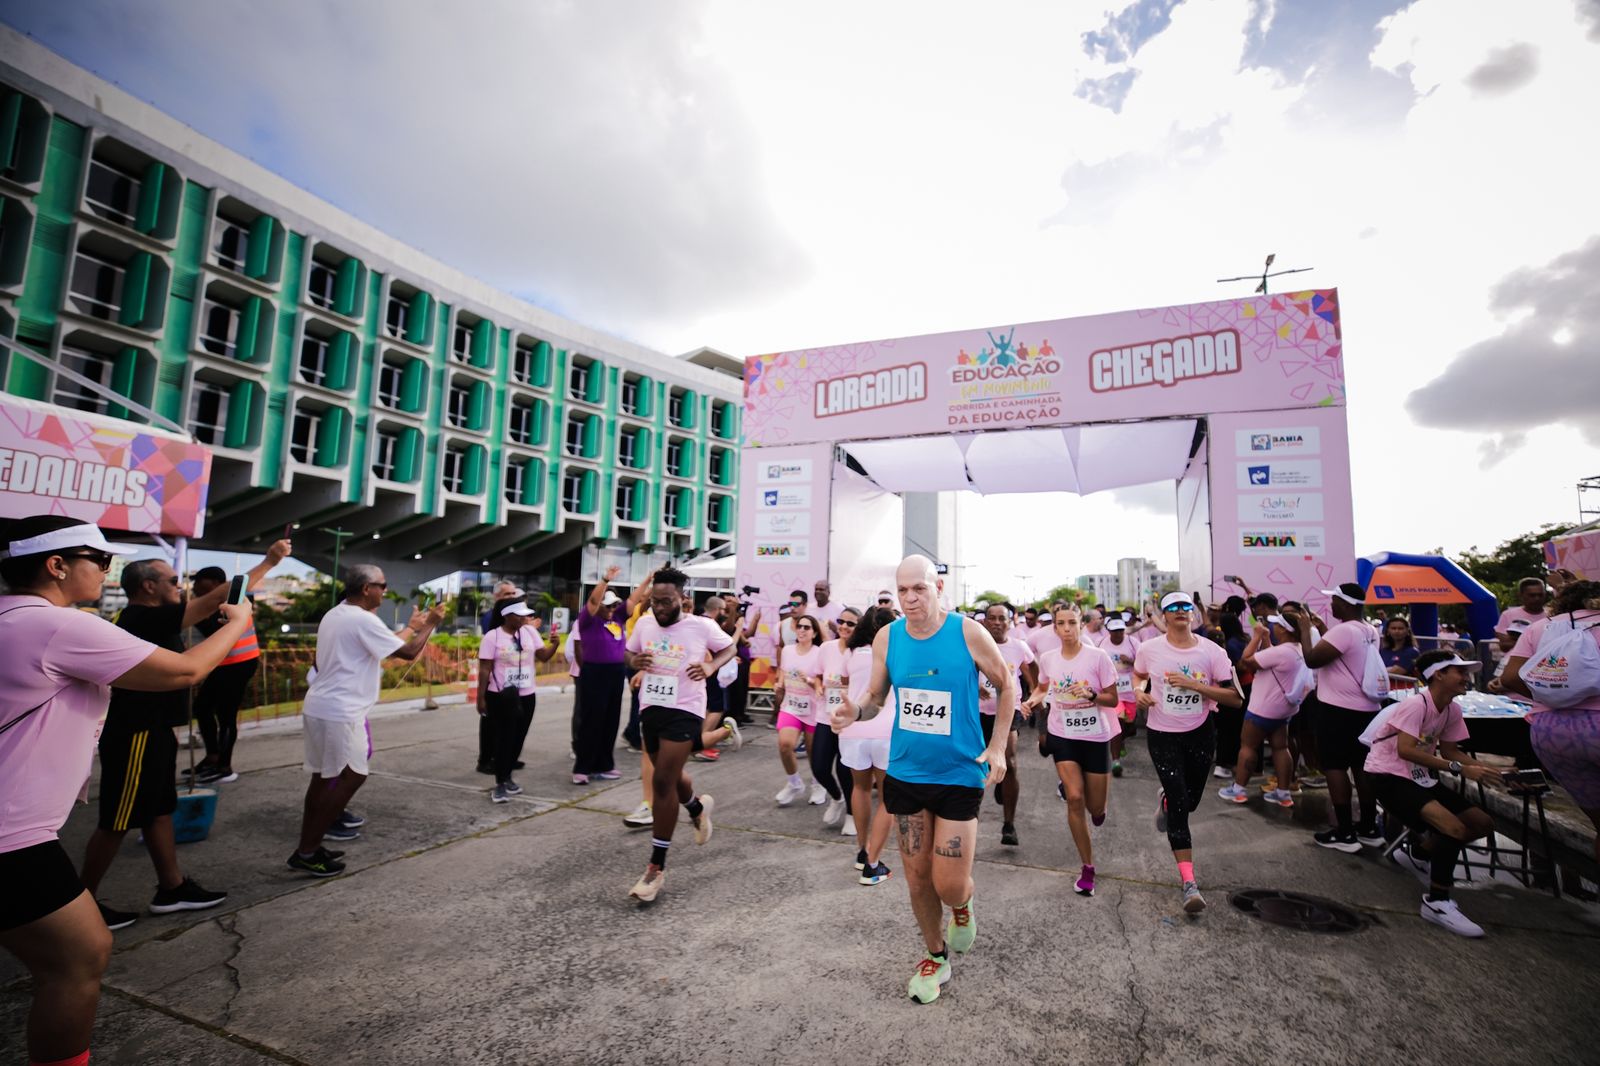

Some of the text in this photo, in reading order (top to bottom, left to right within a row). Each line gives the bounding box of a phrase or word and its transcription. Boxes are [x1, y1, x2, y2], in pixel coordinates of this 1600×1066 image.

[1091, 331, 1240, 390] CHEGADA
[952, 356, 1061, 383] EDUCAÇÃO
[815, 363, 926, 417] LARGADA
[949, 402, 991, 412] CORRIDA
[1001, 396, 1063, 408] CAMINHADA
[948, 404, 1061, 425] DA EDUCAÇÃO
[1272, 435, 1304, 443] BAHIA
[1243, 536, 1297, 547] BAHIA
[757, 546, 791, 556] BAHIA
[646, 684, 674, 696] 5411
[1166, 694, 1200, 705] 5676
[903, 702, 946, 719] 5644
[1066, 716, 1097, 727] 5859
